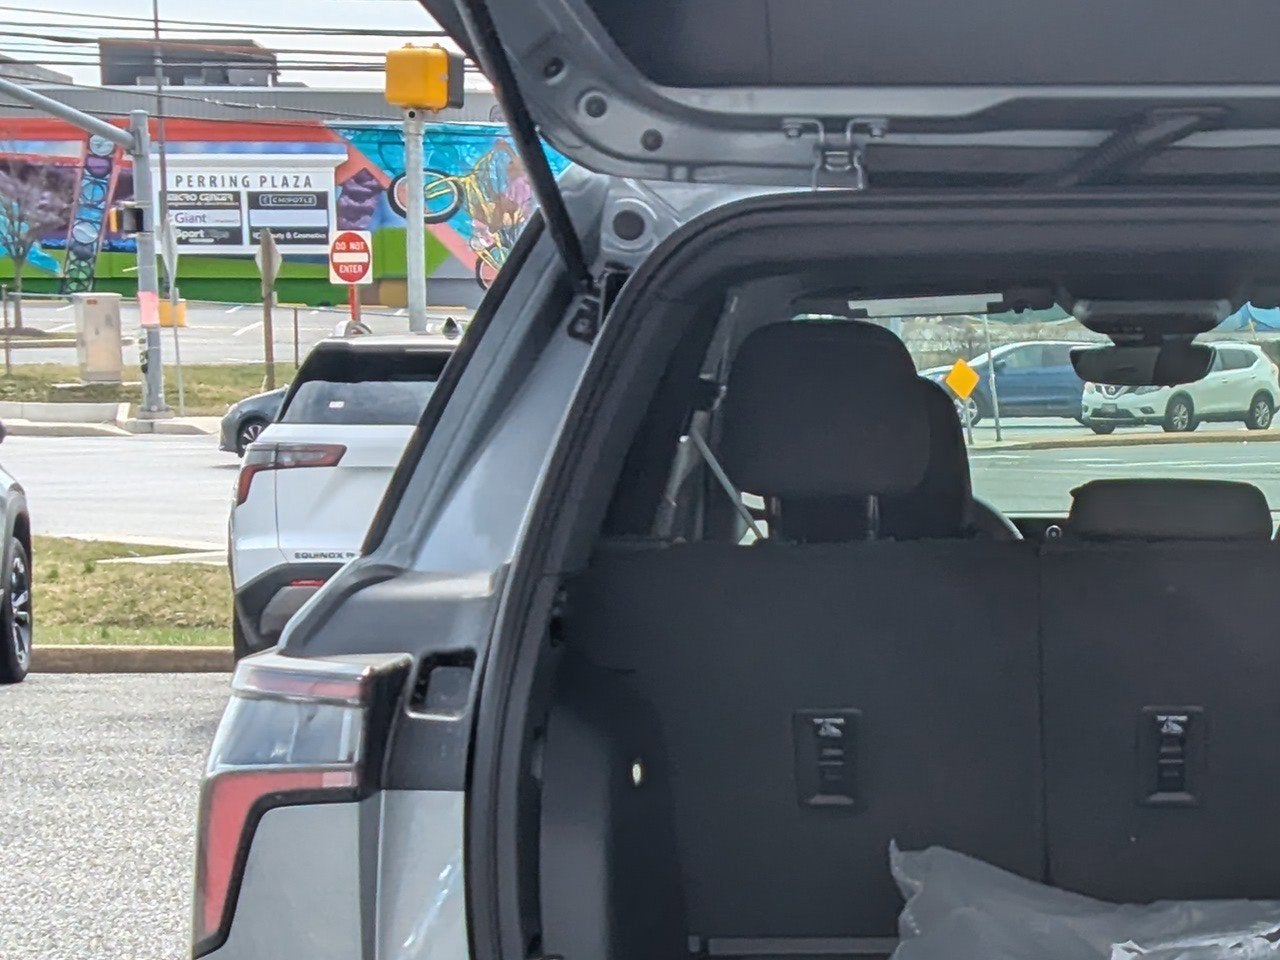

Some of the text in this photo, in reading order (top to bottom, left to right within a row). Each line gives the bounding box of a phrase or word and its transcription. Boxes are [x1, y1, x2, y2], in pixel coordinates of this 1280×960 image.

[175, 175, 312, 188] PERRING PLAZA
[175, 212, 207, 224] Giant
[335, 241, 365, 250] DO NOT
[339, 264, 363, 274] ENTER
